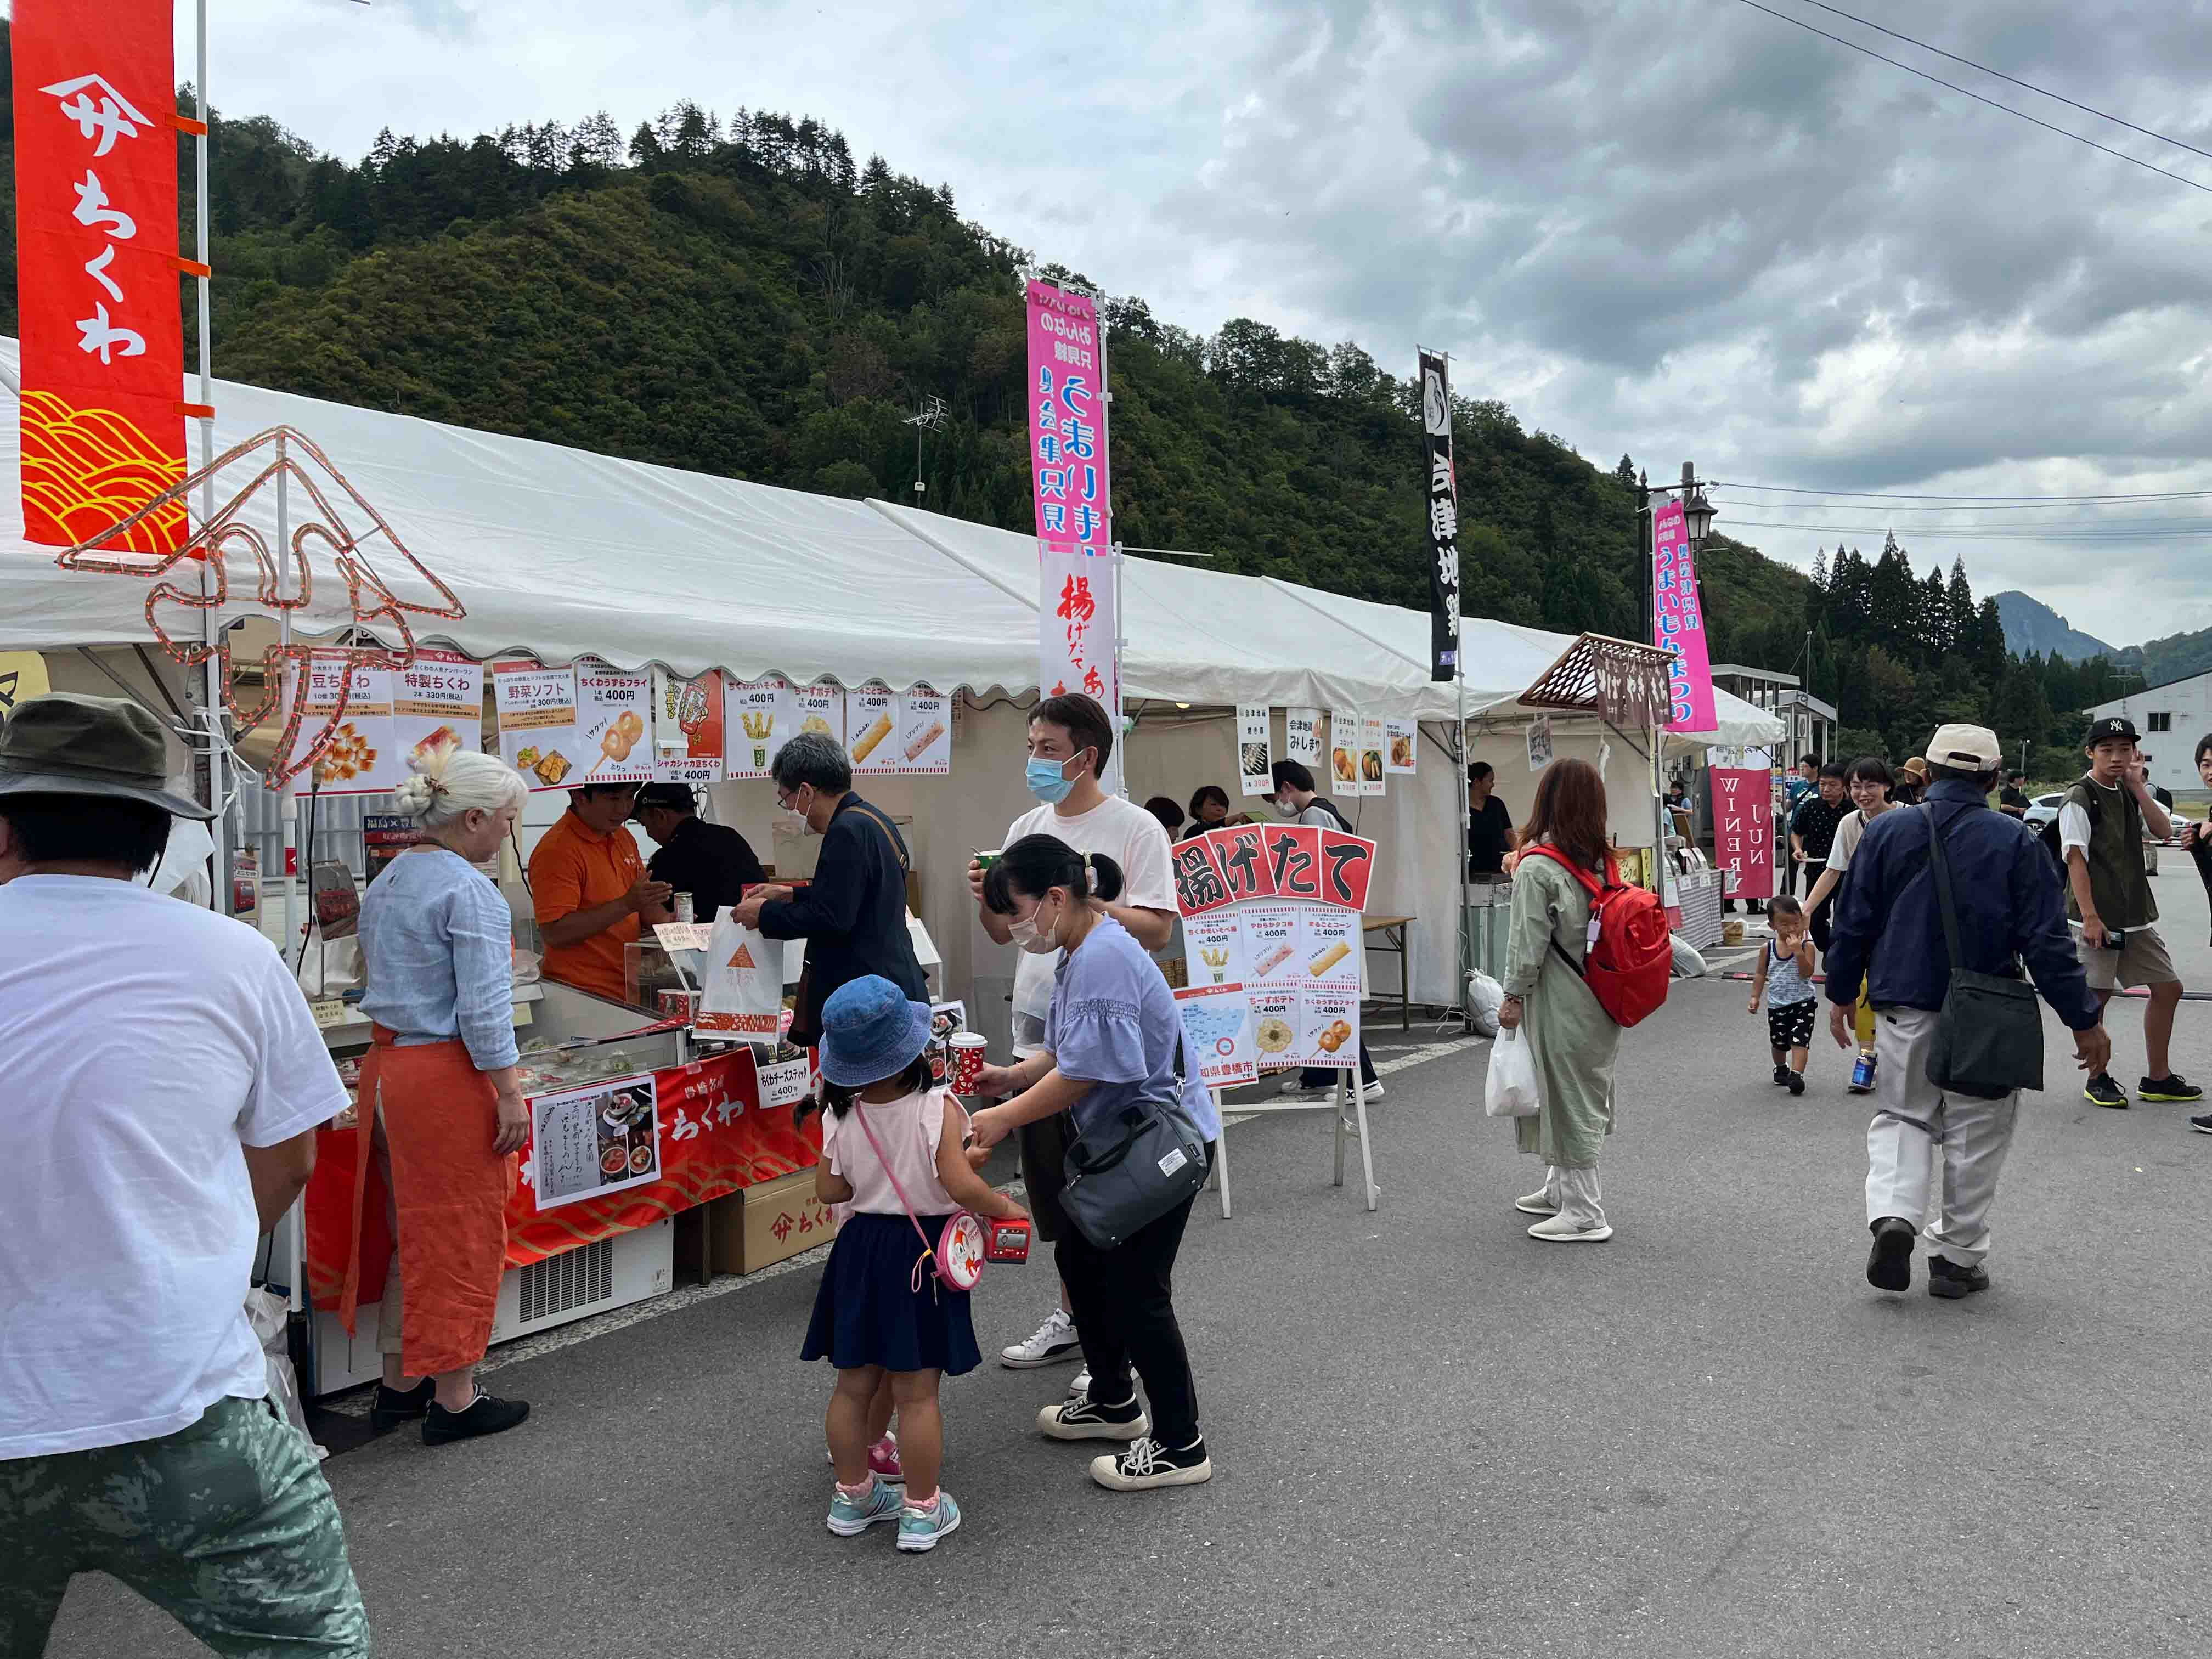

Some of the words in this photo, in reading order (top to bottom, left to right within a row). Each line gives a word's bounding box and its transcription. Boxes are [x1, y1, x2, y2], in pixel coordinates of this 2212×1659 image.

[73, 168, 146, 365] ちくわ
[1057, 573, 1096, 670] 揚げたて
[1657, 546, 1694, 723] うまいもんまつり
[312, 674, 370, 688] 豆ちわ
[405, 673, 470, 691] 特製ちくわ
[581, 678, 647, 687] ちくわうずらフライ
[509, 683, 564, 699] 野菜ソフト
[606, 690, 634, 700] 400円
[426, 692, 463, 701] 330円(税込)
[538, 697, 572, 706] 300円(税込)
[749, 693, 774, 703] 400円
[808, 699, 829, 708] 400円
[867, 698, 888, 707] 400円
[918, 701, 939, 710] 400円
[2110, 720, 2123, 731] NY
[658, 759, 720, 768] シャカシャカ豆ちくわ
[684, 770, 710, 780] 400円
[1172, 833, 1367, 909] 揚げたて
[761, 1066, 807, 1087] ちくわチーズスティック
[672, 1091, 744, 1141] ちくわ
